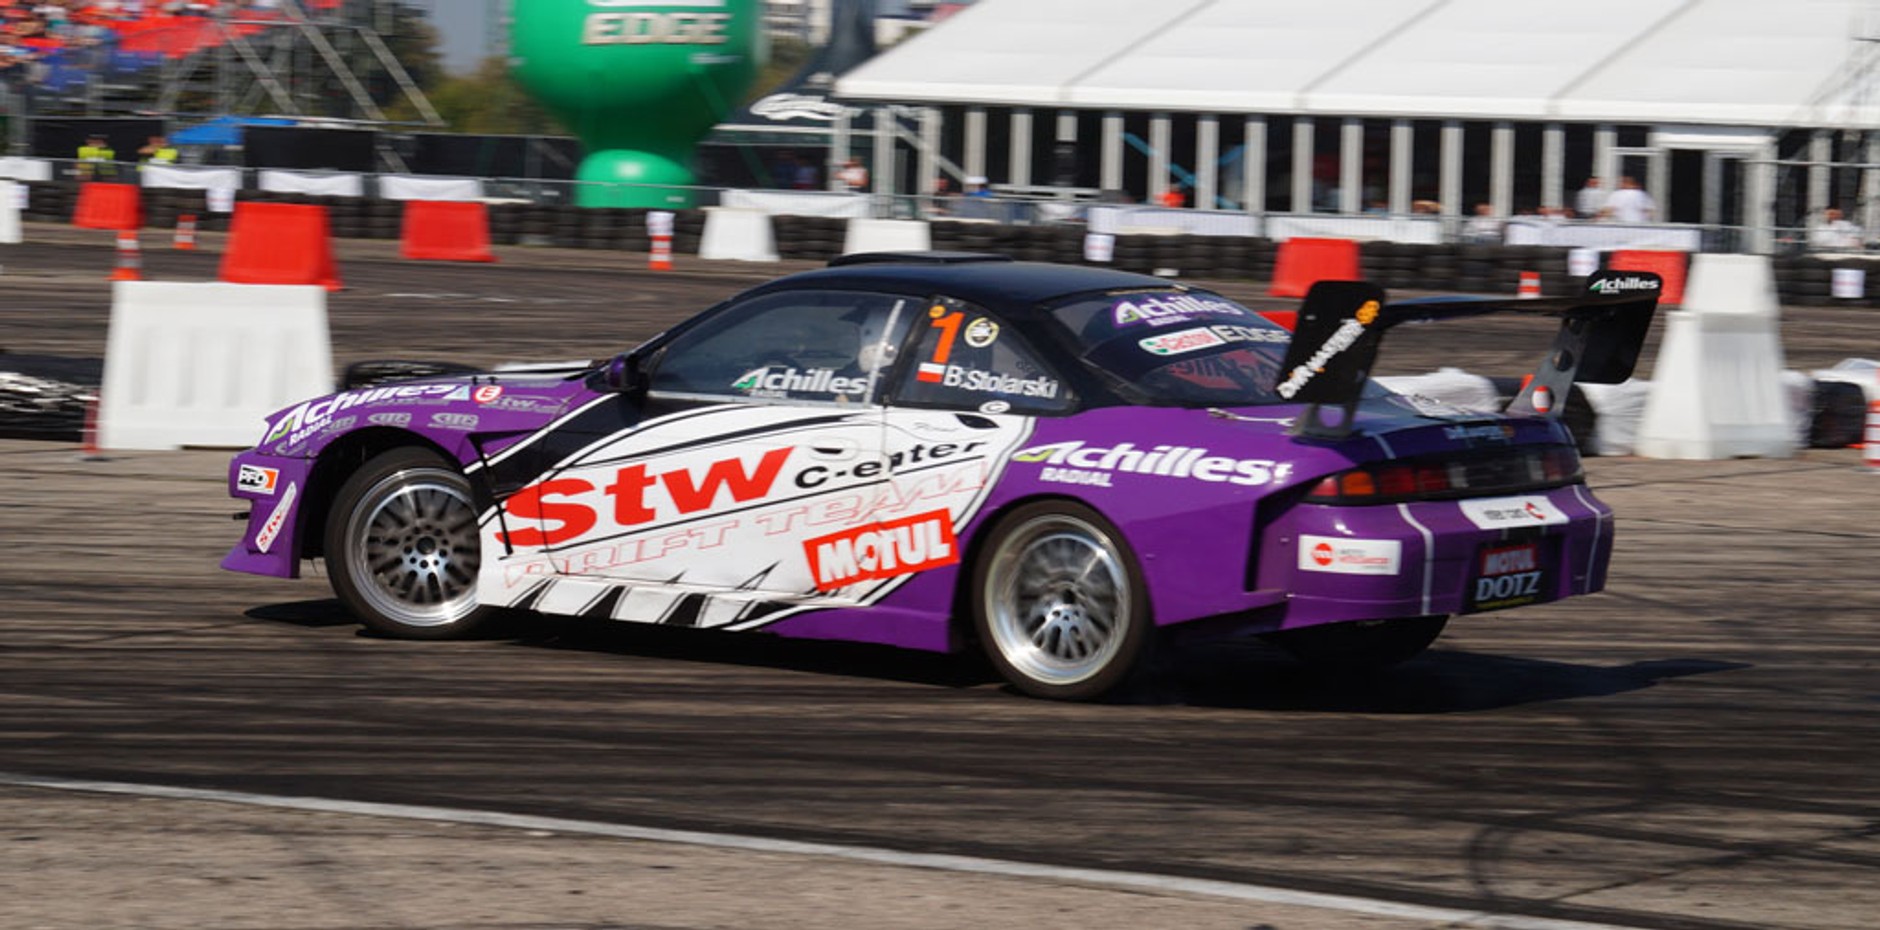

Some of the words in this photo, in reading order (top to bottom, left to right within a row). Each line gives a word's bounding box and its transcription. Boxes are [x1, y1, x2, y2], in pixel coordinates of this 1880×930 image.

[581, 13, 732, 45] EDGE
[1589, 277, 1659, 291] Achilles
[1115, 296, 1243, 324] Achilles
[930, 312, 965, 364] 1
[731, 366, 869, 394] Achilles
[263, 385, 460, 446] Achilles
[289, 415, 332, 447] RADIAL
[1011, 440, 1275, 485] Achilles
[1040, 467, 1113, 487] RADIAL
[495, 446, 795, 547] Stw
[794, 441, 988, 489] C-enter
[504, 519, 740, 589] DRIFT
[755, 461, 989, 537] TEAM
[817, 519, 951, 584] MOTUL
[1483, 548, 1536, 576] MOTUL
[1474, 570, 1543, 602] DOTZ
